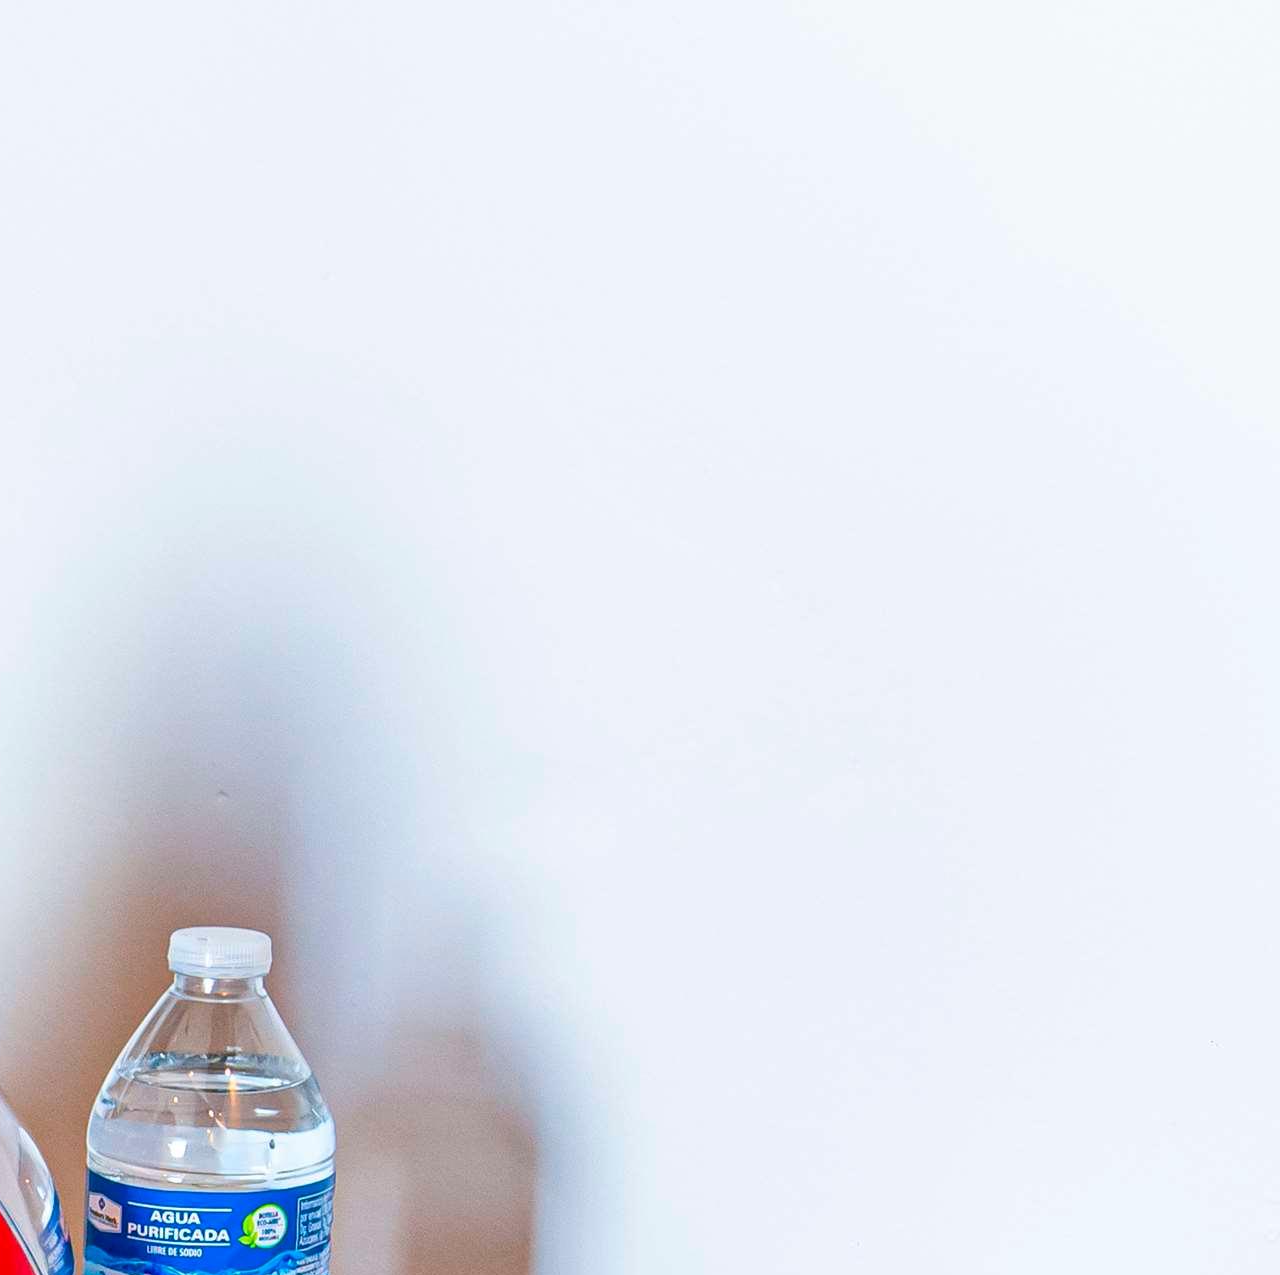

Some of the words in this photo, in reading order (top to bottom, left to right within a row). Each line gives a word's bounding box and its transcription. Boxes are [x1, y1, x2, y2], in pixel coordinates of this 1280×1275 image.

[150, 1209, 200, 1225] AGUA
[127, 1221, 230, 1242] PURIFICADA
[168, 1247, 178, 1256] DE
[179, 1247, 202, 1257] SODIO
